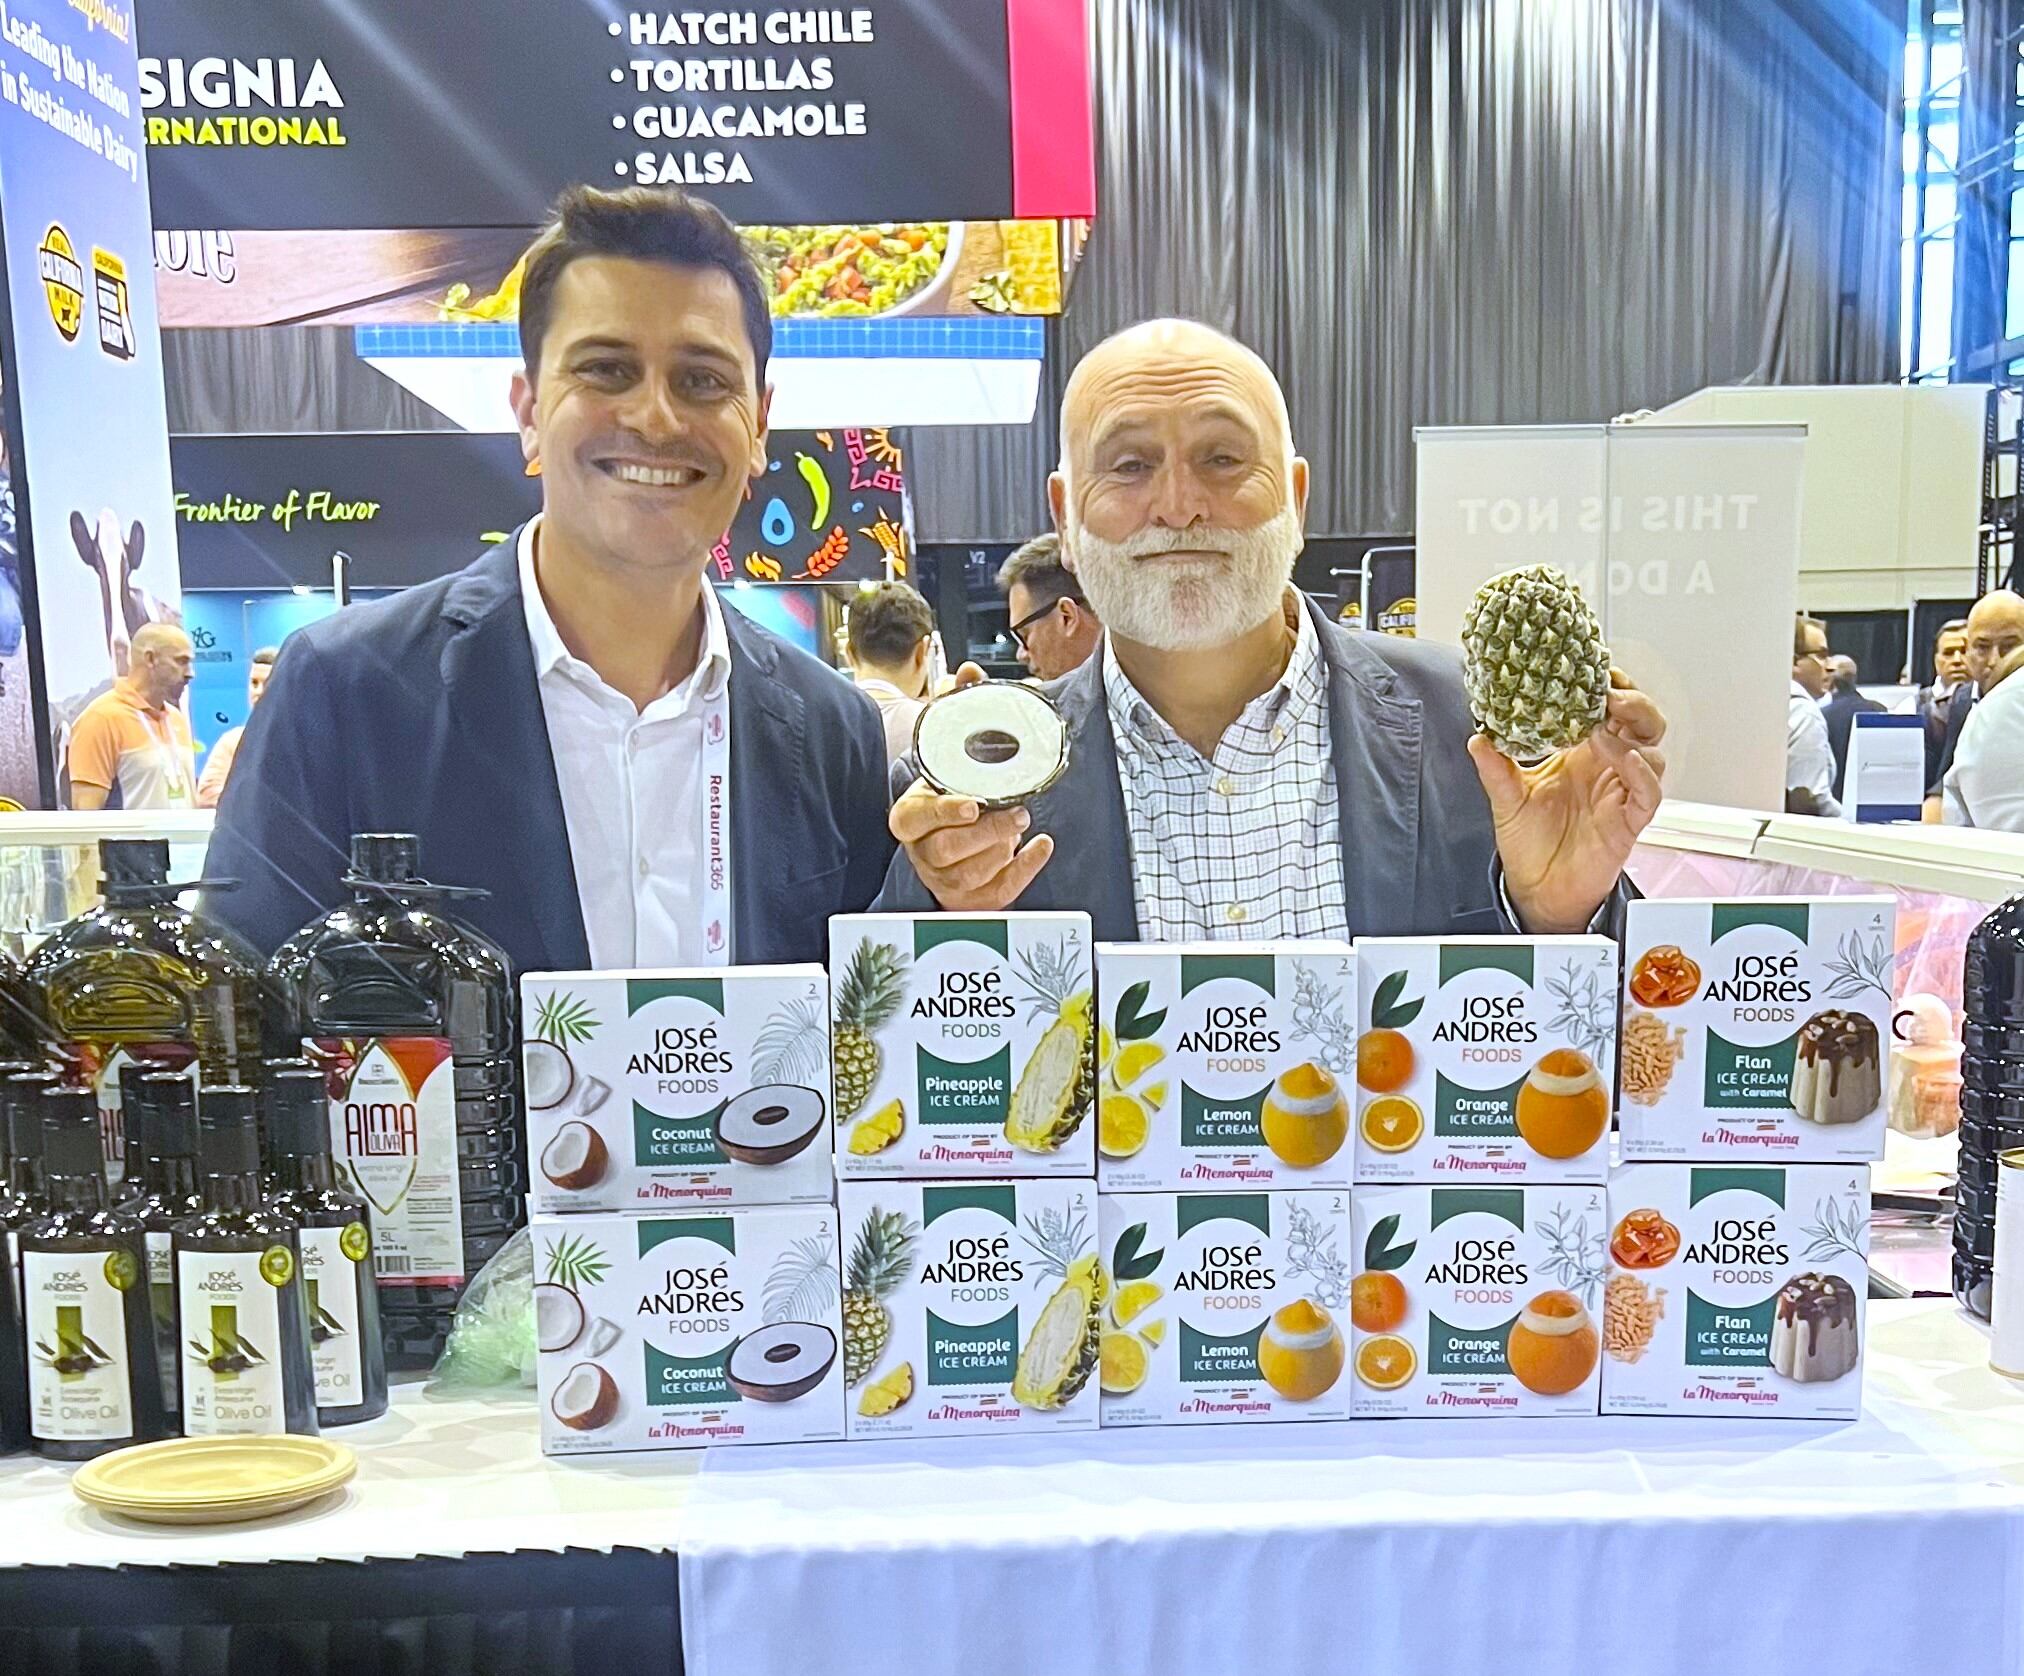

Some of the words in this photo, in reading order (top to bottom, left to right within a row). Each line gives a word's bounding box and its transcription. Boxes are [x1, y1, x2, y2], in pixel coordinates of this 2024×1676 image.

[629, 11, 757, 45] HATCH
[764, 9, 874, 44] CHILE
[0, 1, 61, 82] Leading
[61, 44, 86, 90] the
[87, 59, 130, 119] Nation
[629, 57, 834, 93] TORTILLAS
[0, 60, 18, 105] in
[18, 72, 103, 155] Sustainable
[103, 124, 138, 183] Dairy
[632, 103, 867, 139] GUACAMOLE
[143, 116, 347, 146] RNATIONAL
[634, 151, 754, 184] SALSA
[173, 492, 265, 521] Frontier
[271, 488, 302, 532] of
[306, 491, 380, 521] Flavor
[709, 774, 724, 891] Restaurant365
[1872, 914, 1881, 924] 4
[1069, 928, 1077, 939] 2
[1600, 949, 1609, 960] 2
[1340, 958, 1348, 970] 2
[808, 983, 817, 994] 2
[1733, 1007, 1795, 1022] FOODS
[941, 1024, 1001, 1038] FOODS
[1462, 1048, 1522, 1062] FOODS
[1735, 1054, 1771, 1069] Flan
[1207, 1058, 1266, 1072] FOODS
[925, 1076, 1003, 1094] Pineapple
[1717, 1073, 1738, 1084] ICE
[1741, 1073, 1788, 1084] CREAM
[658, 1079, 719, 1094] FOODS
[1742, 1088, 1787, 1098] Caramel
[930, 1096, 950, 1106] ICE
[953, 1095, 999, 1106] CREAM
[1455, 1098, 1509, 1114] Orange
[1203, 1108, 1251, 1121] Lemon
[1449, 1115, 1468, 1125] ICE
[1471, 1114, 1513, 1125] CREAM
[652, 1127, 712, 1141] Coconut
[1195, 1125, 1214, 1135] ICE
[1217, 1124, 1259, 1135] CREAM
[650, 1143, 674, 1155] ICE
[677, 1142, 715, 1154] CREAM
[1848, 1179, 1857, 1189] 4
[1075, 1194, 1083, 1205] 2
[1333, 1197, 1341, 1208] 2
[1590, 1194, 1597, 1206] 2
[819, 1221, 828, 1233] 2
[1713, 1270, 1773, 1284] FOODS
[951, 1288, 1010, 1302] FOODS
[1455, 1289, 1513, 1304] FOODS
[1204, 1296, 1261, 1310] FOODS
[669, 1319, 730, 1334] FOODS
[1715, 1315, 1751, 1329] Flan
[1448, 1338, 1500, 1353] Orange
[1697, 1333, 1718, 1344] ICE
[1721, 1333, 1768, 1344] CREAM
[935, 1338, 1011, 1357] Pineapple
[1201, 1345, 1248, 1357] Lemon
[1722, 1347, 1766, 1357] Caramel
[939, 1357, 959, 1368] ICE
[963, 1356, 1007, 1367] CREAM
[1194, 1360, 1212, 1370] ICE
[1215, 1359, 1256, 1370] CREAM
[1442, 1353, 1461, 1363] ICE
[1464, 1353, 1505, 1363] CREAM
[663, 1366, 723, 1381] Coconut
[662, 1383, 685, 1394] ICE
[687, 1381, 726, 1392] CREAM
[214, 1406, 250, 1420] Olive
[252, 1404, 272, 1419] Oil
